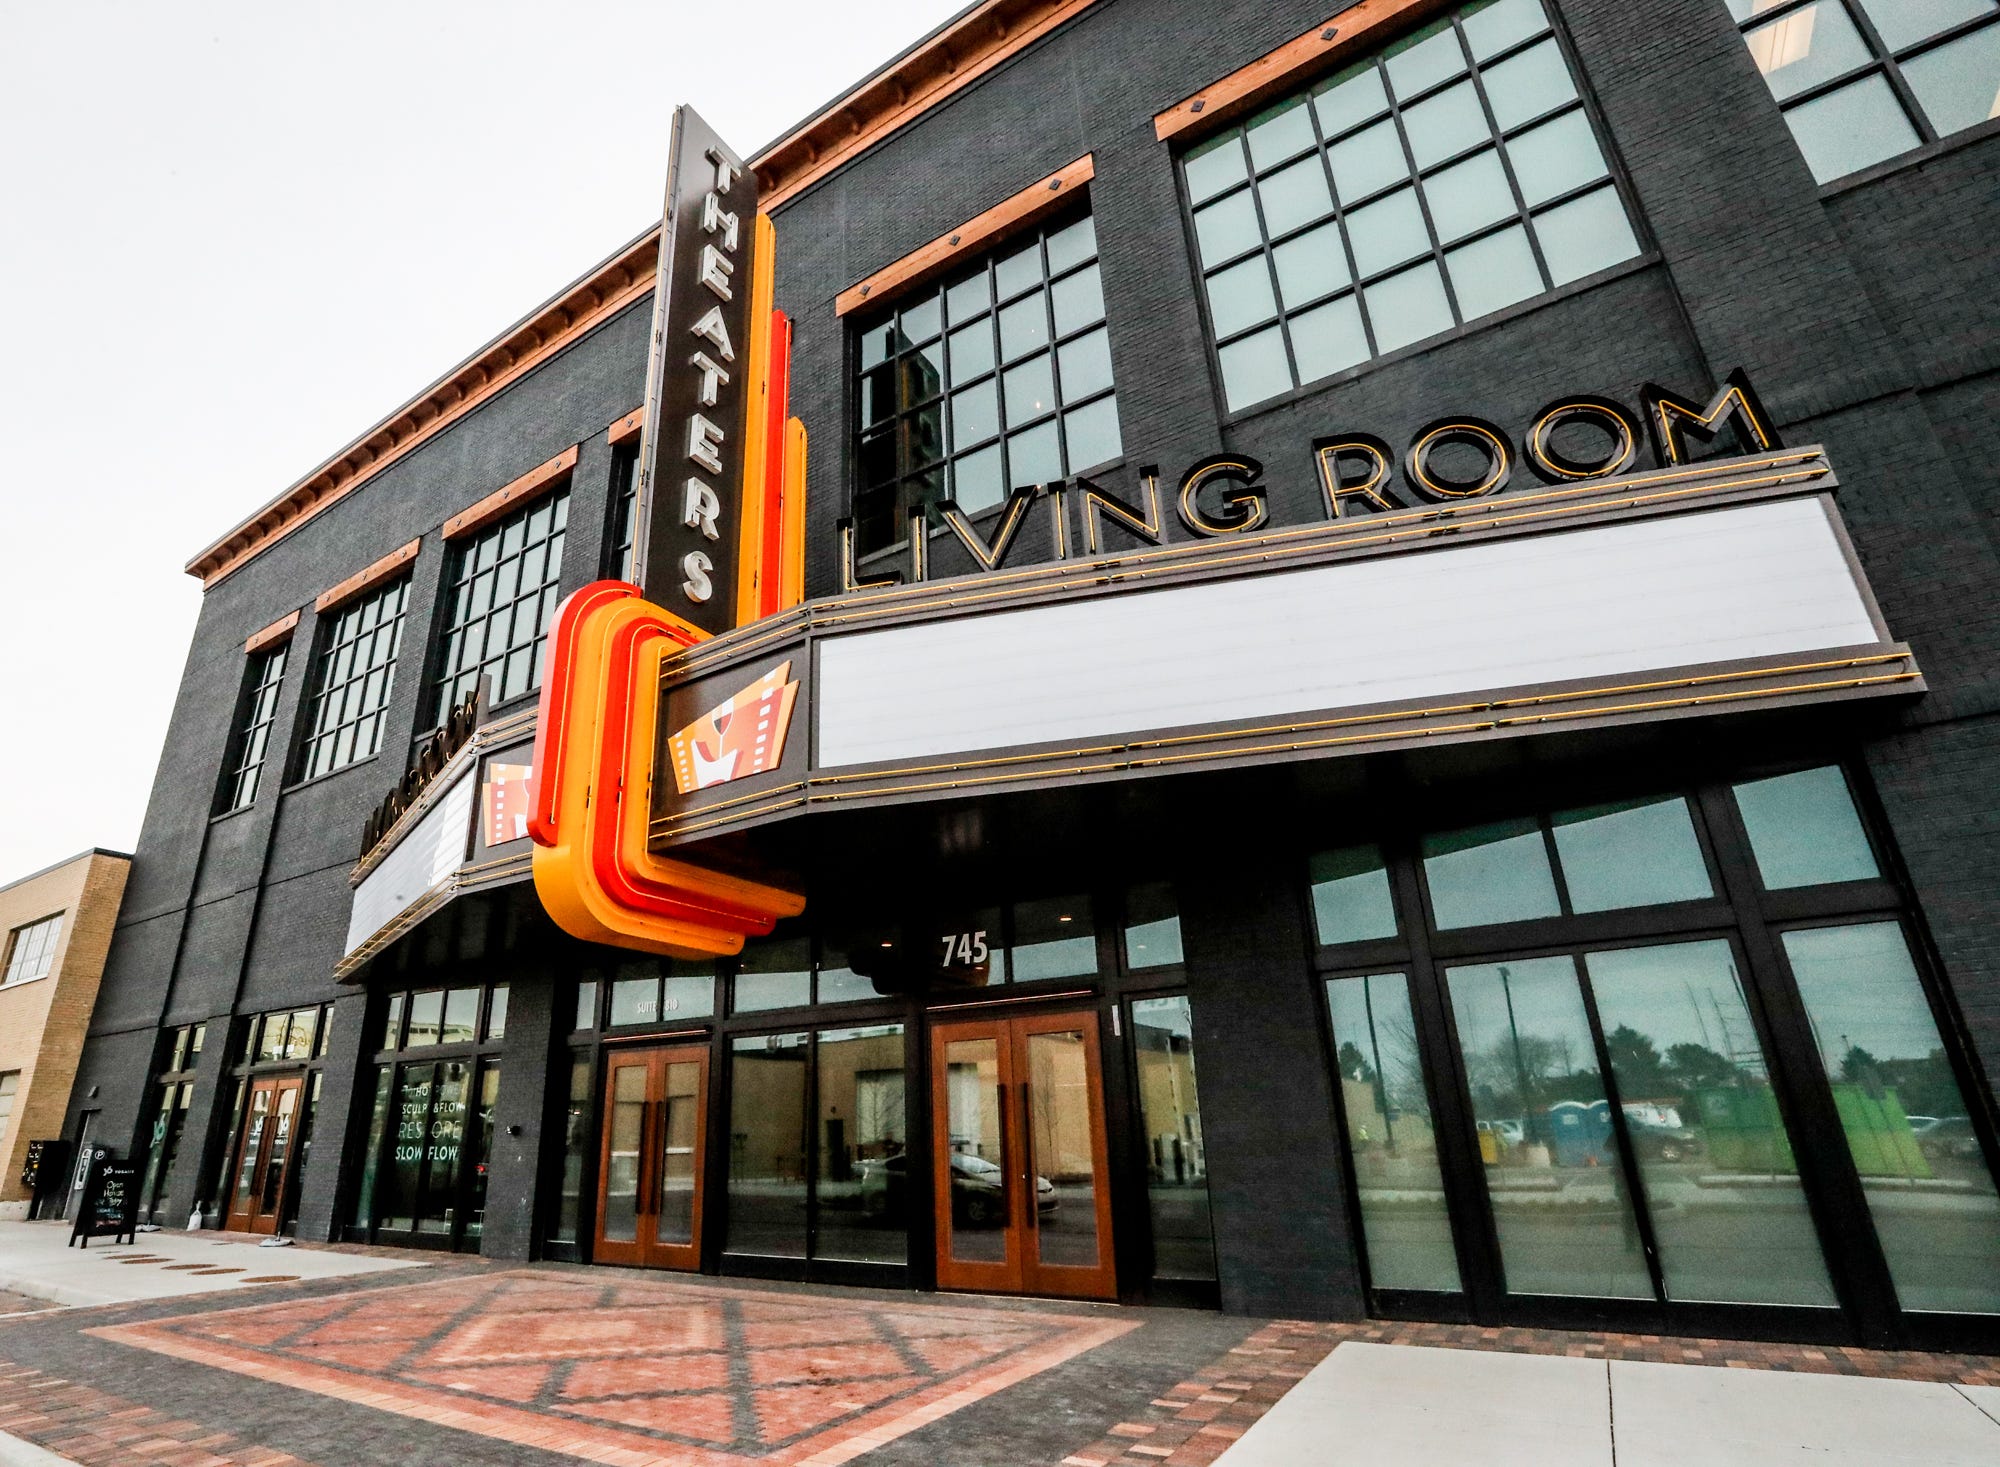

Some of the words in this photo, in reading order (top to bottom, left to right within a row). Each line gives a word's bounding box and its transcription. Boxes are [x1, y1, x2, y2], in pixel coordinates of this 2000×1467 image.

[683, 145, 741, 603] THEATERS
[836, 455, 1270, 594] LIVING
[1312, 366, 1785, 520] ROOM
[942, 931, 988, 967] 745
[637, 1001, 657, 1013] SUITE
[402, 1103, 428, 1114] SCULP
[398, 1120, 461, 1139] RESORE
[395, 1146, 423, 1160] SLOW
[427, 1145, 458, 1160] FLOW
